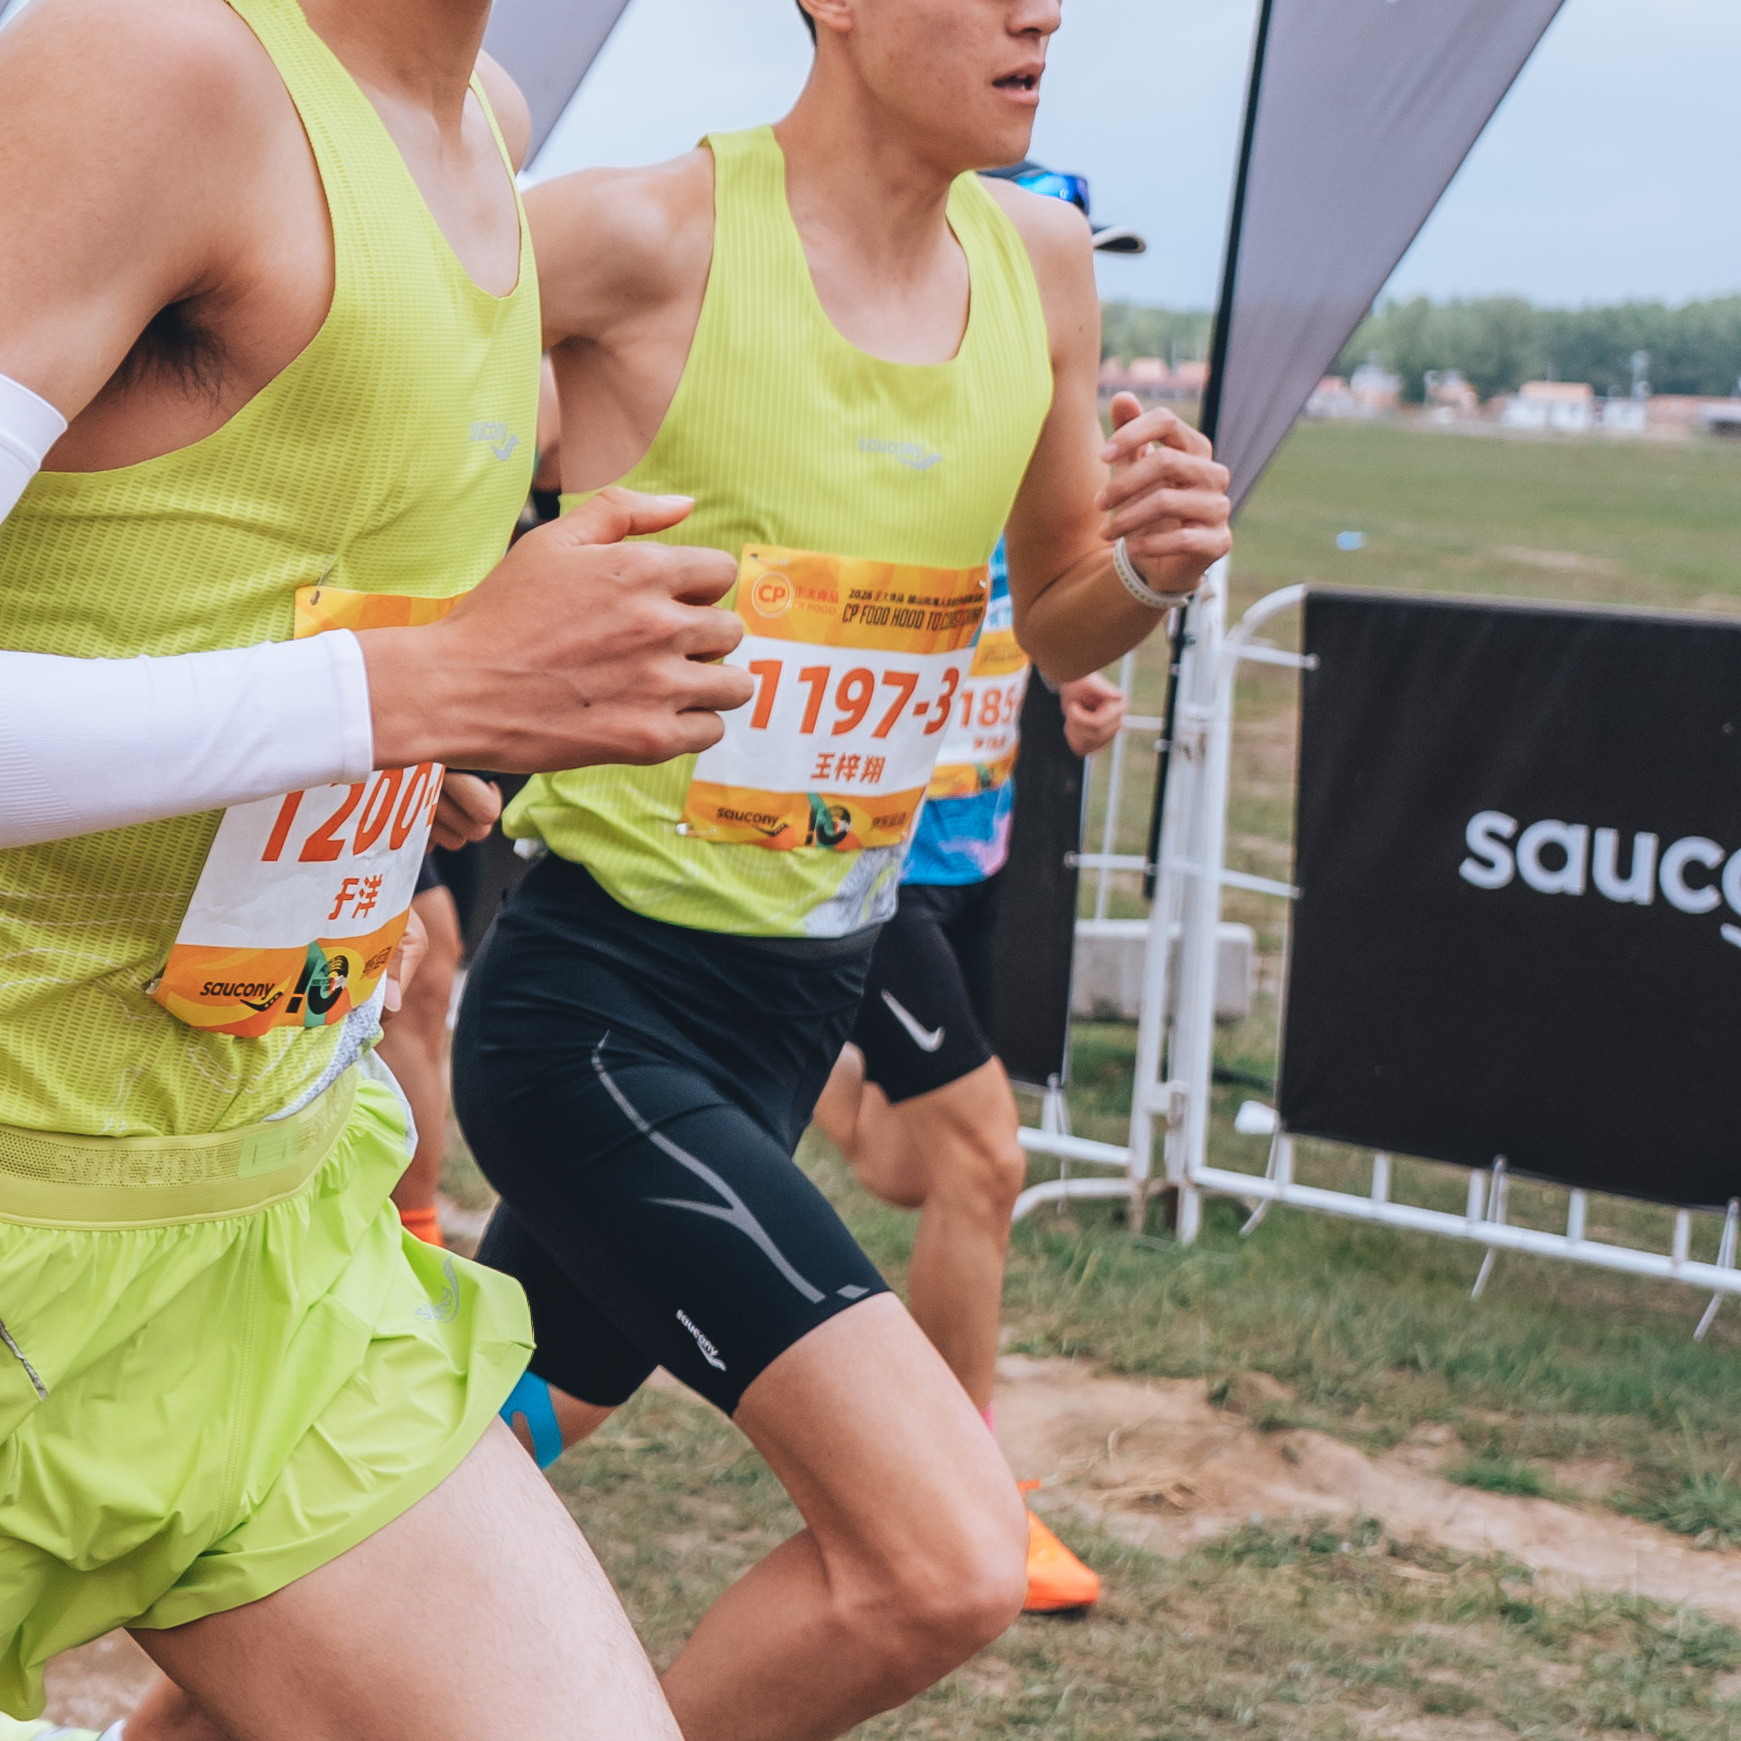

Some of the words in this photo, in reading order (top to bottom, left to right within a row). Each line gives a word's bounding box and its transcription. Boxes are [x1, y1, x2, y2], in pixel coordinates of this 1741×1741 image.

[758, 585, 786, 604] CP
[842, 603, 859, 623] CP
[860, 605, 891, 626] FOOD
[892, 608, 924, 629] HOOD
[926, 611, 941, 631] TO
[749, 659, 960, 739] 1197-3
[810, 753, 886, 784] 王梓翔
[717, 806, 779, 827] saucony
[1460, 810, 1741, 920] sauc
[200, 981, 275, 1000] saucony
[676, 1309, 719, 1357] saucony
